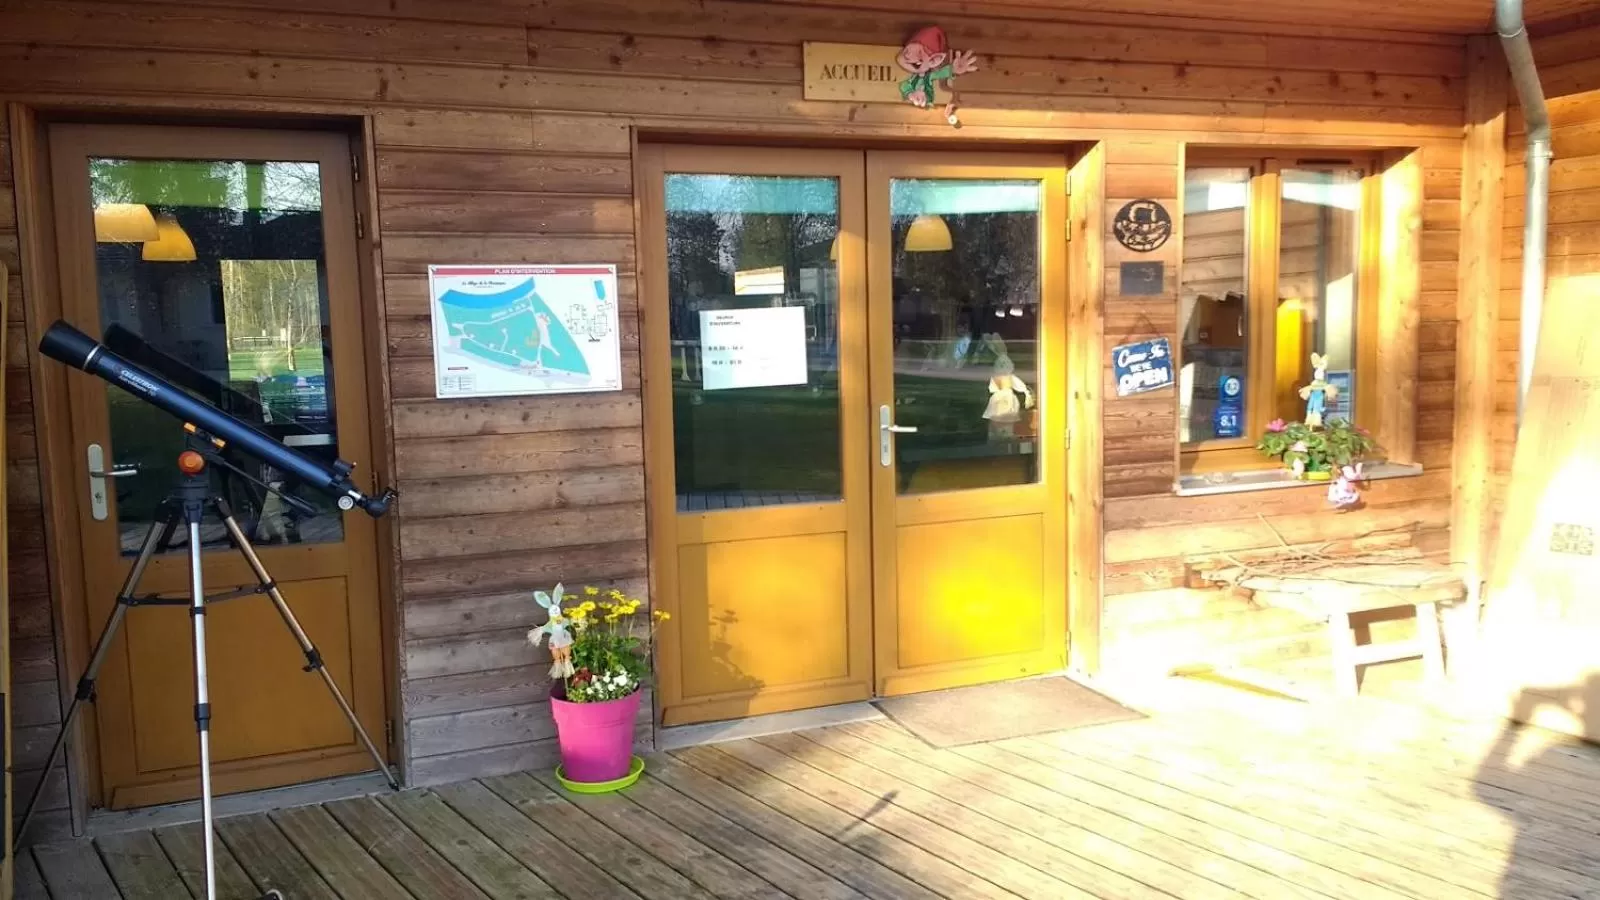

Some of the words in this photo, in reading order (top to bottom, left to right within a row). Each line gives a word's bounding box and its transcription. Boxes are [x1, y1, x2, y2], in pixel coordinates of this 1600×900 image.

[820, 64, 896, 82] ACCUEIL
[121, 369, 160, 391] CELESTRON
[1119, 367, 1168, 391] OPEN
